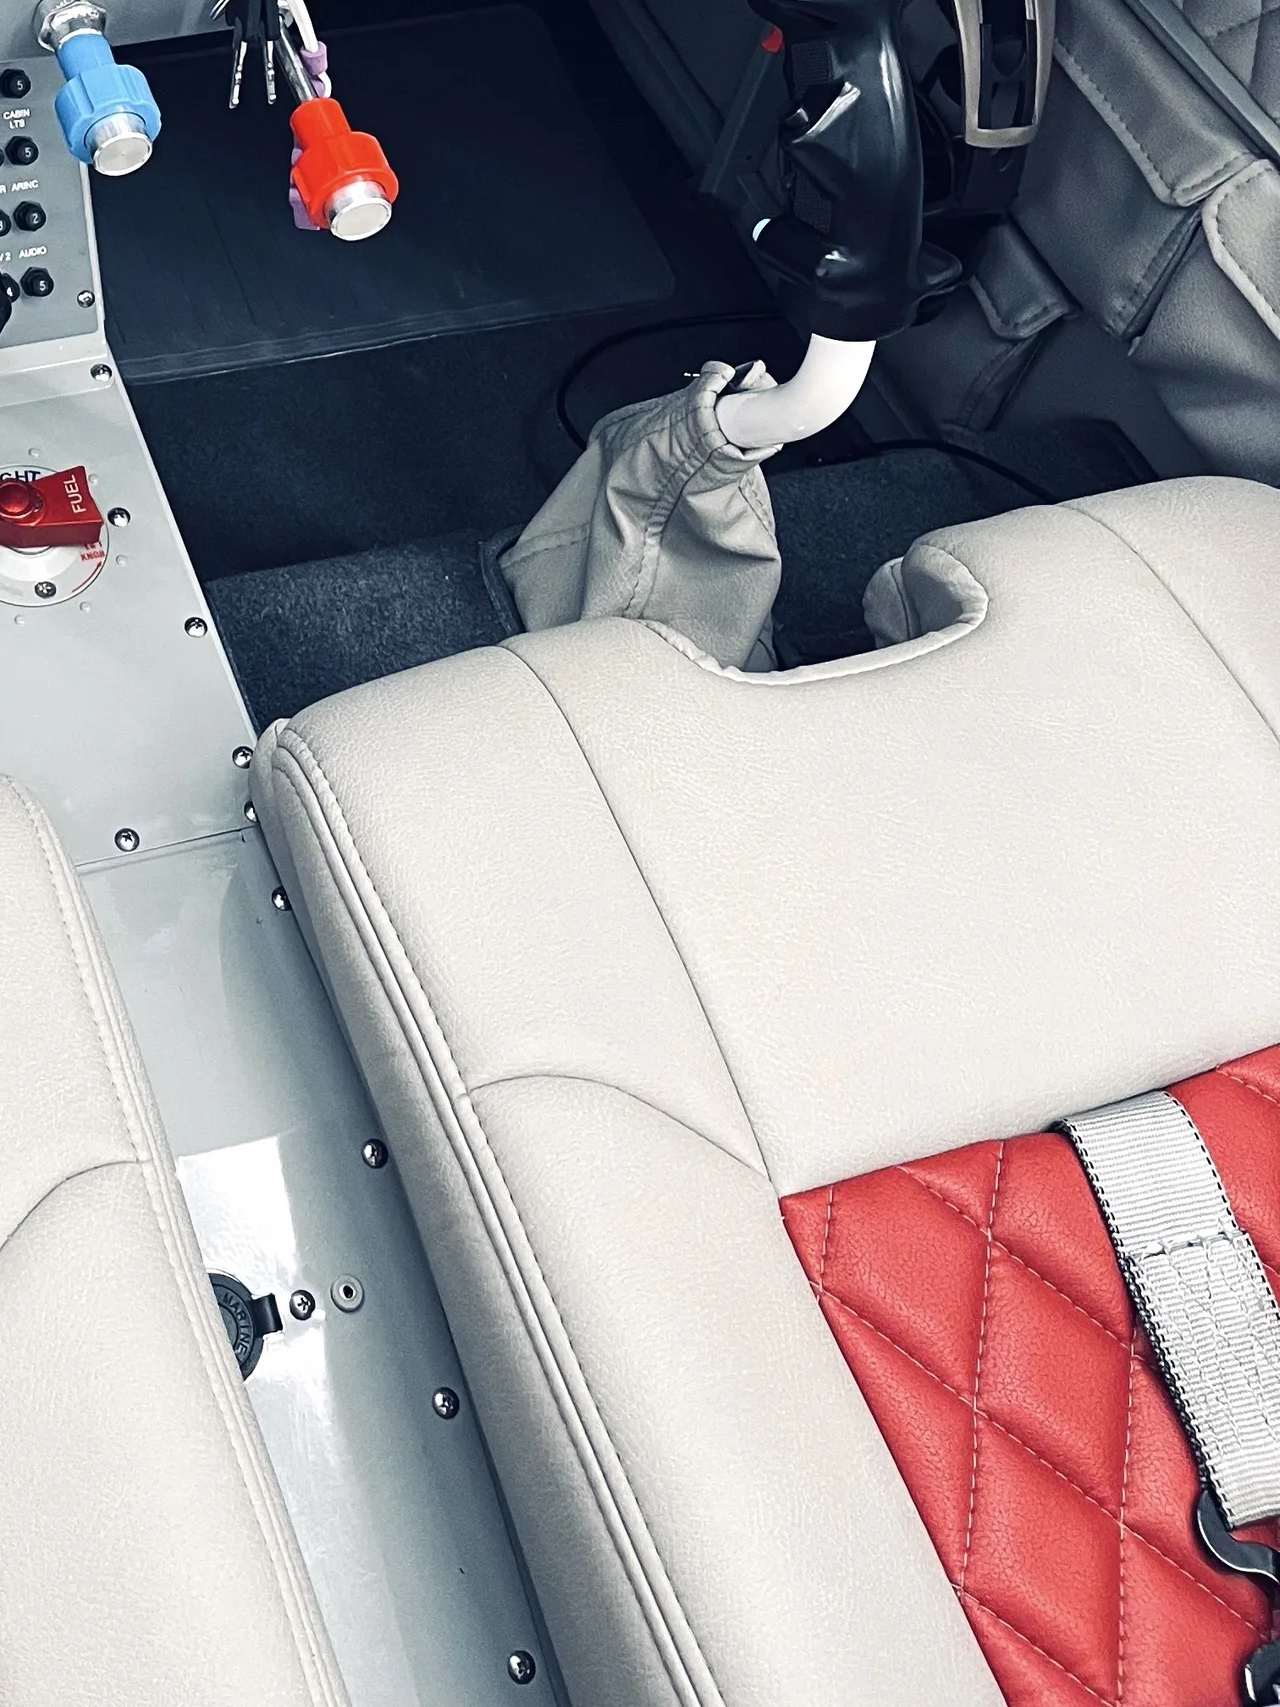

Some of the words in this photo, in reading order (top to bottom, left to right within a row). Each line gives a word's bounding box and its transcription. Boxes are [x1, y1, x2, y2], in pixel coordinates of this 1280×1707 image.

[3, 109, 30, 122] CABIN
[9, 118, 26, 129] LTS
[12, 179, 39, 192] ARINC
[19, 246, 47, 259] AUDIO
[63, 474, 89, 514] FUEL
